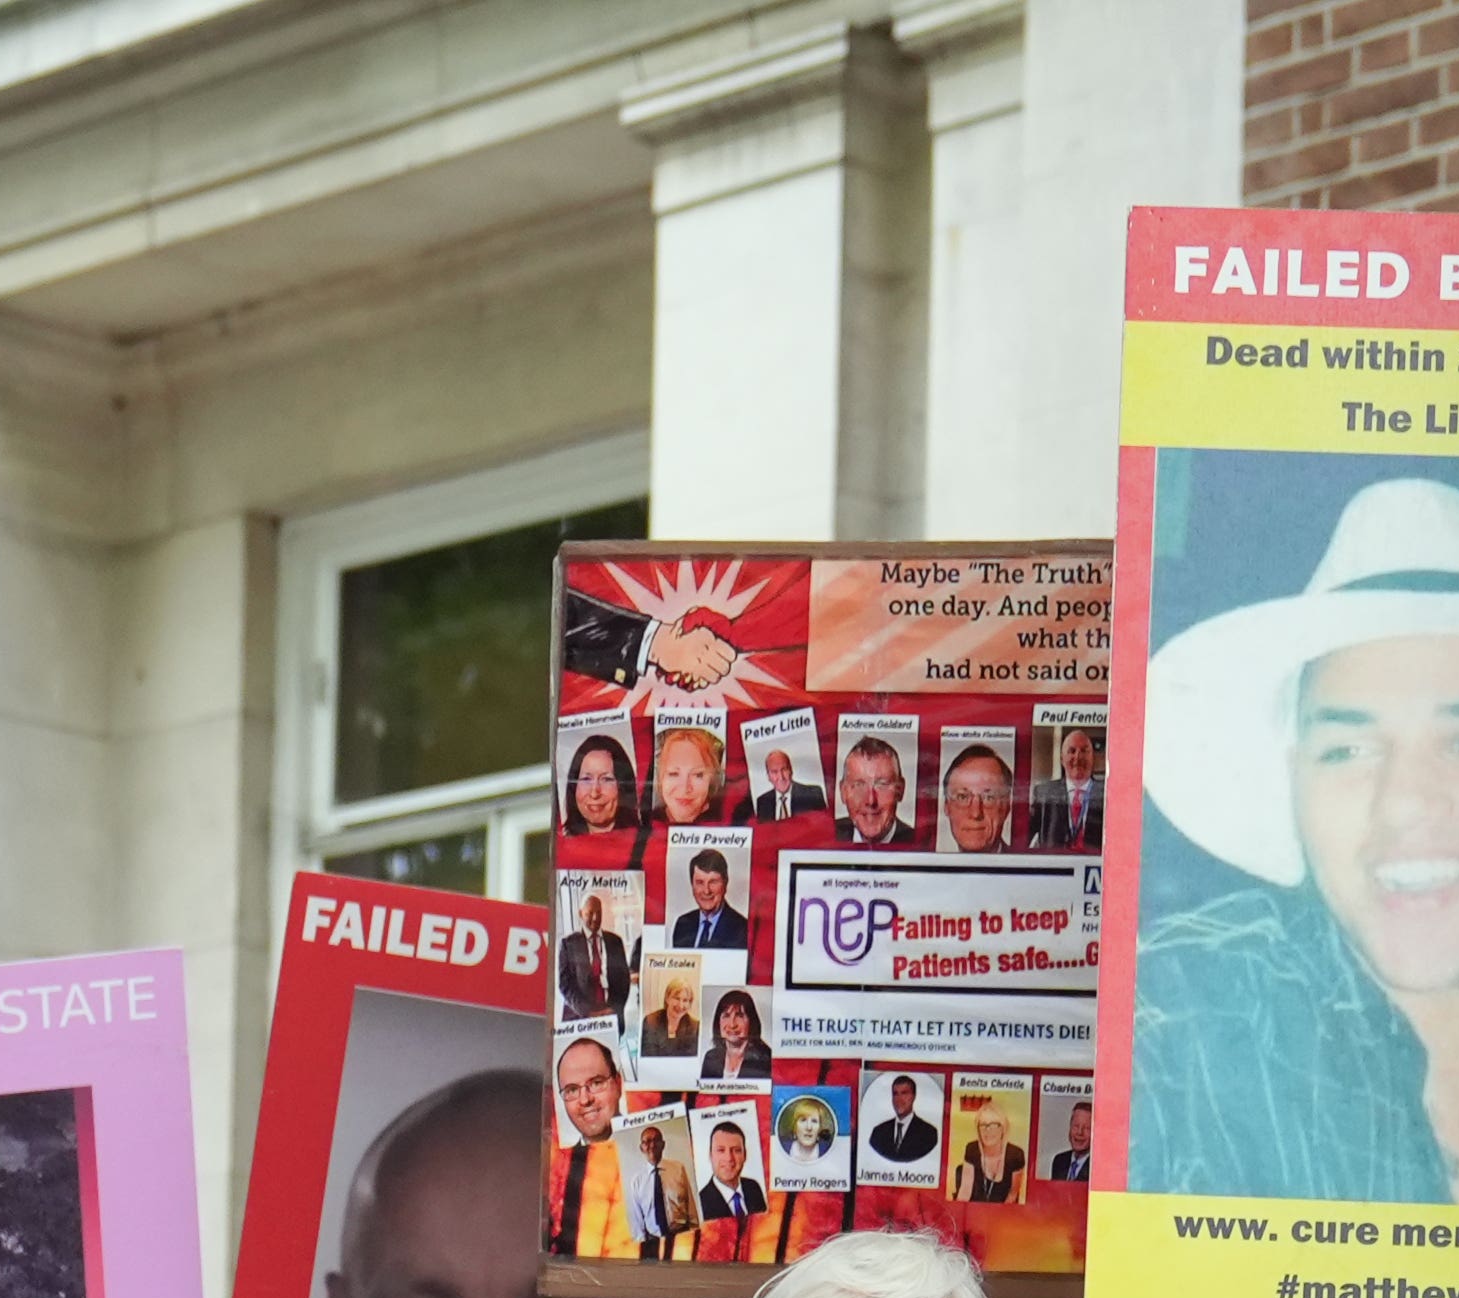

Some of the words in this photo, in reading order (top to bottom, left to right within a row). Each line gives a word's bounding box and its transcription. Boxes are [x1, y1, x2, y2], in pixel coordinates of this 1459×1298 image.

[1206, 336, 1309, 368] Dead
[1322, 339, 1445, 372] within
[1341, 402, 1412, 433] The
[881, 563, 960, 588] Maybe
[889, 598, 934, 615] one
[942, 595, 990, 620] day.
[998, 596, 1047, 615] And
[1017, 629, 1078, 649] what
[926, 659, 971, 679] had
[979, 662, 1020, 680] not
[1028, 660, 1076, 680] said
[658, 715, 692, 725] Emma
[696, 715, 721, 729] Ling
[744, 726, 776, 740] Peter
[780, 717, 811, 732] Little
[671, 833, 699, 844] Chris
[704, 834, 747, 847] Paveley
[560, 877, 589, 888] Andy
[592, 878, 628, 887] Mattin
[893, 952, 990, 980] Patients
[782, 1018, 812, 1032] THE
[817, 1019, 864, 1033] TRUST
[871, 1020, 910, 1035] THAT
[917, 1021, 942, 1036] LET
[949, 1022, 971, 1036] ITS
[978, 1023, 1053, 1039] PATIENTS
[1060, 1026, 1090, 1040] DIE!
[623, 1116, 645, 1126] Peter
[775, 1177, 806, 1189] Penny
[810, 1178, 847, 1190] Rogers
[857, 1169, 894, 1182] James
[898, 1170, 934, 1182] Moore
